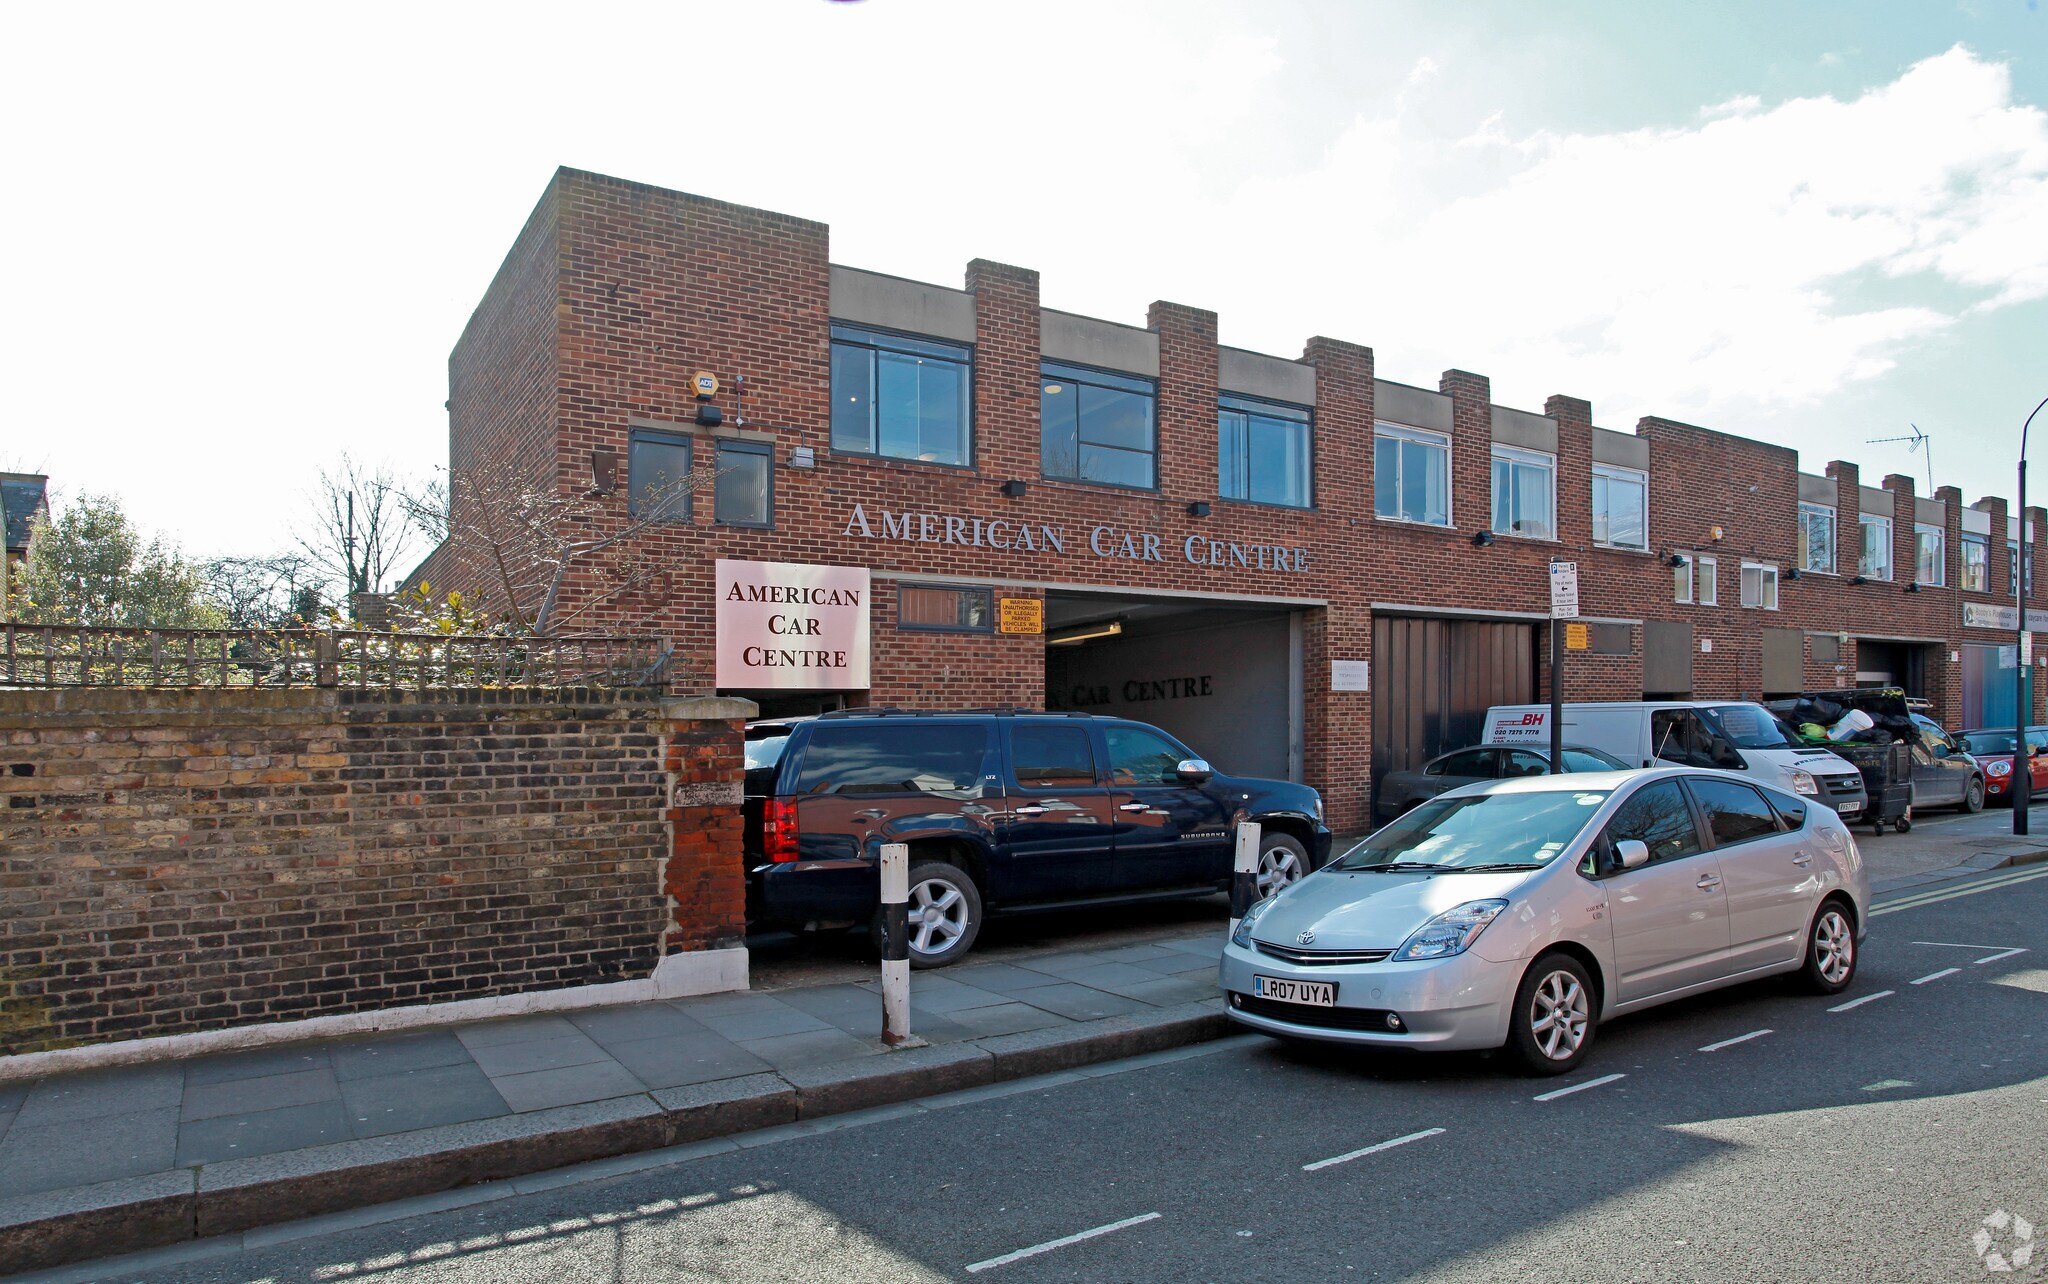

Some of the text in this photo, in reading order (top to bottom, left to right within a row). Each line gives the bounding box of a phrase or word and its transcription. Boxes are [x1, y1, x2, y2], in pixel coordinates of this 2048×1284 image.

[699, 379, 713, 387] ADT
[842, 503, 1309, 573] AMERICAN CAR CENTRE
[726, 581, 861, 607] AMERICAN
[768, 614, 822, 636] CAR
[742, 646, 847, 668] CENTRE
[1072, 685, 1112, 707] CAR
[1123, 675, 1212, 702] CENTRE
[1522, 713, 1544, 725] BH
[1261, 979, 1331, 1004] LR07 UYA
